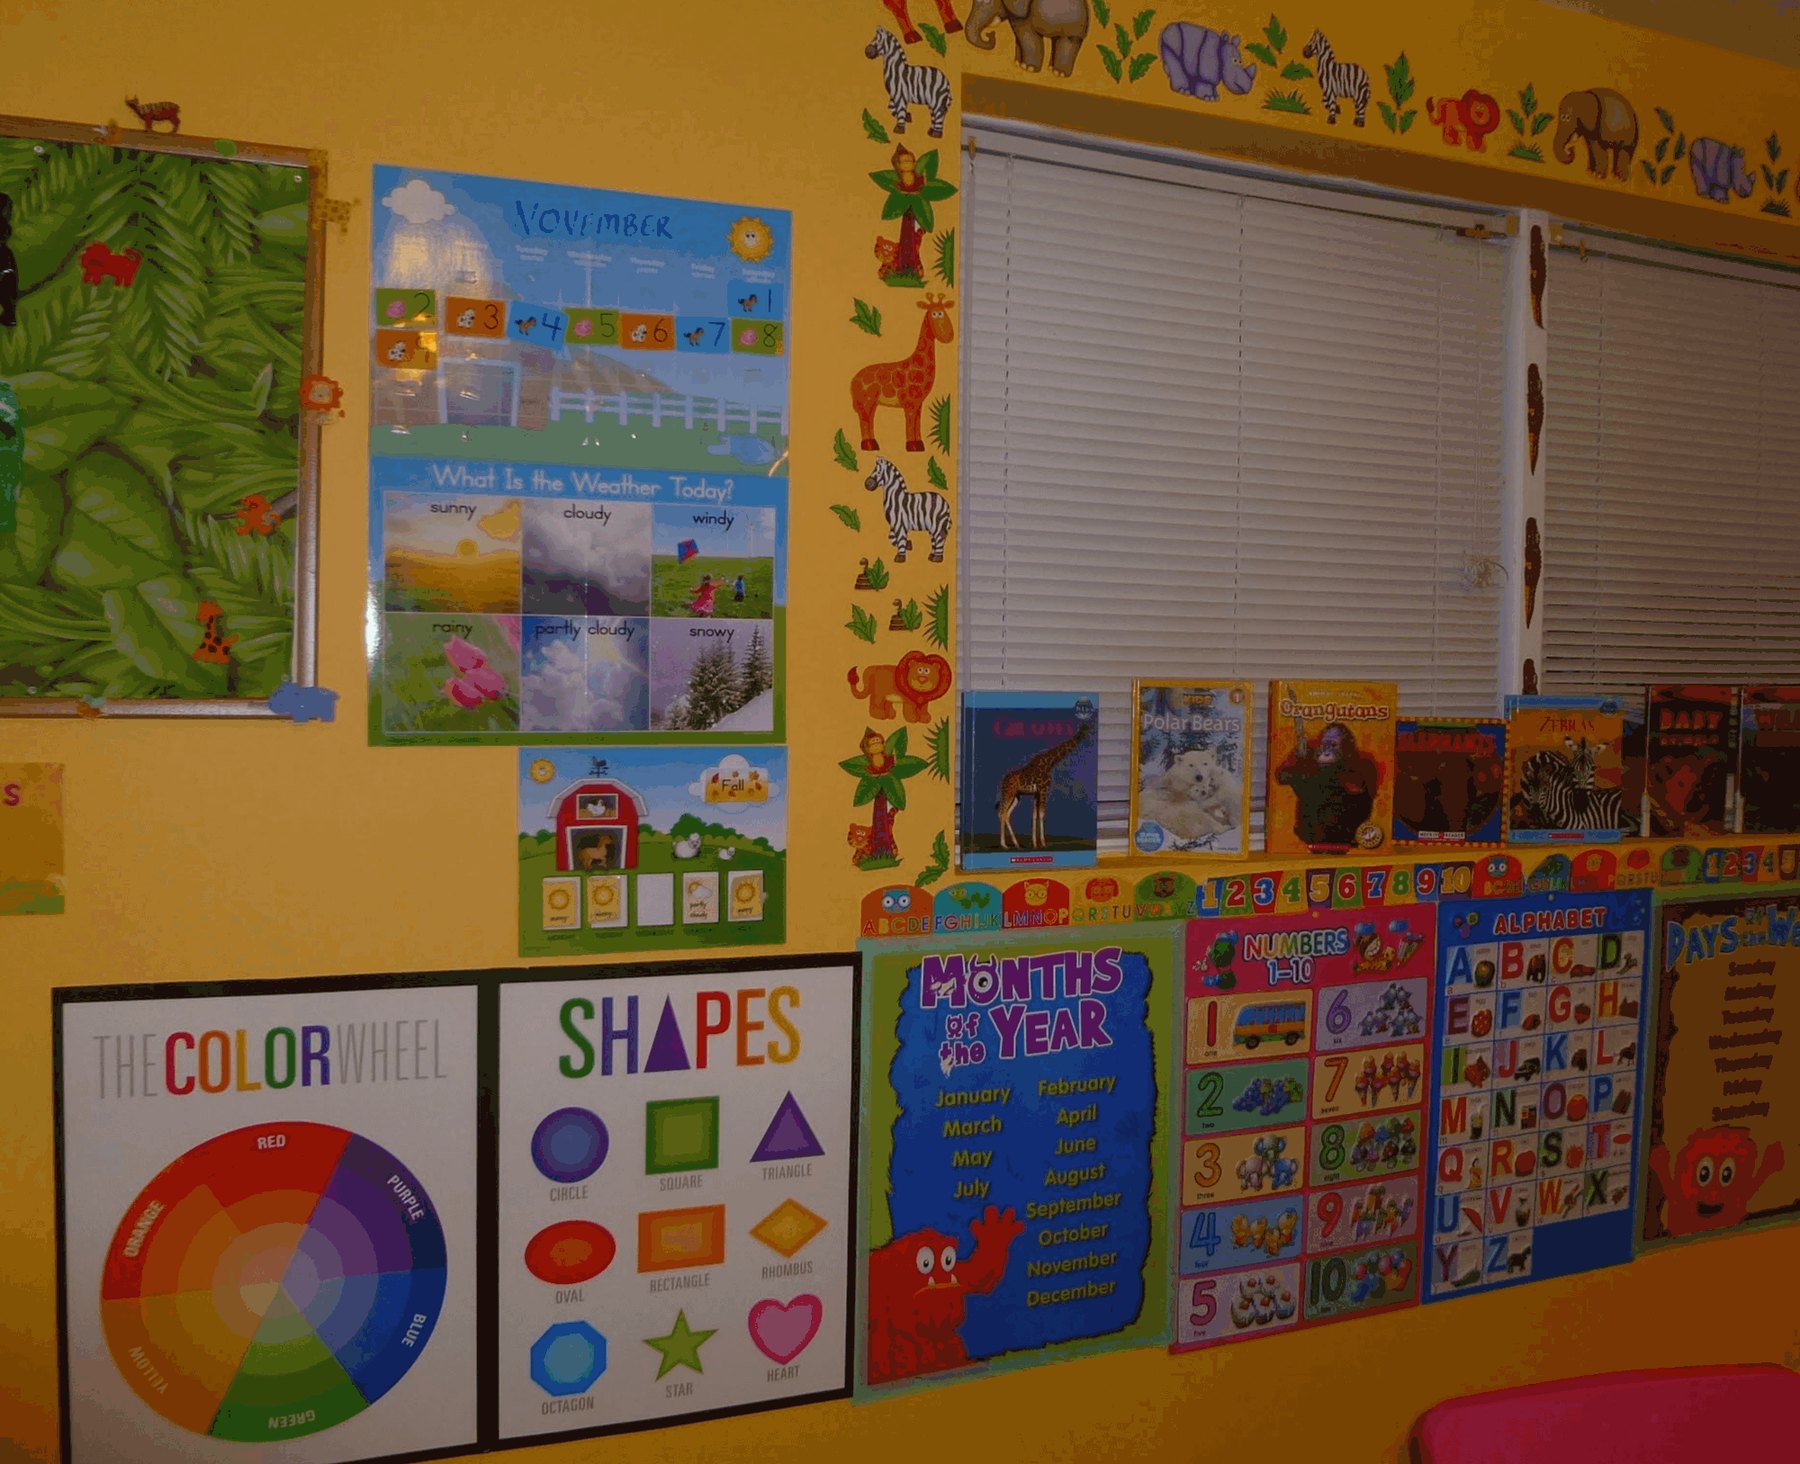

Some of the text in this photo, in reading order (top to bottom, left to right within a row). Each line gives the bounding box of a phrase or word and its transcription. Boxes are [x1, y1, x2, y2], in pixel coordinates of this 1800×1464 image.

[484, 304, 499, 330] 3
[541, 316, 562, 341] 4
[600, 313, 615, 338] 5
[653, 318, 668, 343] 6
[708, 321, 725, 346] 7
[762, 323, 777, 348] 8
[431, 464, 734, 502] What Is the Weather Today?
[430, 502, 477, 520] sunny
[563, 505, 612, 526] cloudy
[692, 511, 734, 531] windy
[432, 620, 473, 639] rainy
[535, 620, 635, 641] partly cloudy
[689, 626, 735, 642] snowy
[1143, 714, 1240, 732] Polar Bears
[1280, 699, 1390, 722] Orangutans
[722, 779, 745, 792] Fall
[1723, 851, 1739, 876] 2
[1742, 851, 1758, 874] 3
[1203, 880, 1218, 909] 1
[1226, 878, 1246, 908] 2
[1253, 876, 1275, 906] 3
[1282, 876, 1302, 903] 4
[1309, 873, 1330, 902] 5
[1337, 872, 1357, 899] 6
[1366, 871, 1387, 898] 7
[1391, 869, 1411, 896] 8
[1416, 867, 1436, 895] 9
[1440, 866, 1472, 894] 10
[862, 915, 930, 936] ABCDE
[1003, 908, 1068, 929] LMNOP
[1493, 906, 1607, 936] ALPHABET
[1243, 927, 1351, 961] NUMBERS
[1666, 914, 1739, 973] DAYS
[1267, 957, 1315, 986] 1-10
[1449, 934, 1622, 984] A B C D
[920, 946, 1124, 1009] MONTHS
[1326, 989, 1352, 1034] 6
[1448, 981, 1618, 1035] E F G H
[945, 1010, 981, 1039] of
[988, 999, 1114, 1060] YEAR
[1206, 1000, 1217, 1047] 1
[93, 1018, 447, 1100] THE COLOR WHEEL
[939, 1040, 987, 1070] the
[1498, 1040, 1517, 1078] J
[1546, 1034, 1568, 1072] K
[1597, 1030, 1614, 1065] L
[1038, 1074, 1117, 1098] February
[1324, 1056, 1349, 1103] 7
[934, 1085, 1011, 1109] January
[1197, 1072, 1224, 1118] 2
[1441, 1076, 1613, 1136] M N O P
[943, 1117, 1002, 1138] March
[1055, 1105, 1097, 1127] April
[257, 1134, 287, 1150] RED
[1054, 1136, 1097, 1157] June
[1319, 1124, 1346, 1171] 8
[1438, 1124, 1611, 1182] Q R S T
[762, 1163, 813, 1181] TRIANGLE
[952, 1149, 993, 1170] May
[1194, 1142, 1222, 1188] 3
[659, 1174, 703, 1192] SQUARE
[953, 1178, 990, 1199] July
[1044, 1163, 1107, 1187] August
[387, 1174, 424, 1222] PURPLE
[549, 1185, 588, 1202] CIRCLE
[1026, 1191, 1122, 1221] September
[1438, 1170, 1608, 1233] U V W X
[123, 1200, 165, 1257] ORANGE
[1317, 1192, 1344, 1238] 9
[1038, 1222, 1109, 1247] October
[1189, 1212, 1222, 1257] 4
[762, 1261, 813, 1280] RHOMBUS
[1026, 1250, 1117, 1278] November
[1437, 1236, 1508, 1282] Y Z
[649, 1273, 711, 1293] RECTANGLE
[1026, 1280, 1117, 1308] December
[1309, 1258, 1347, 1305] 10
[555, 1289, 584, 1305] OVAL
[1189, 1279, 1217, 1326] 5
[401, 1313, 427, 1349] BLUE
[129, 1344, 169, 1394] YELLOW
[766, 1365, 800, 1383] HEART
[665, 1382, 694, 1398] STAR
[268, 1409, 316, 1430] GREEN
[541, 1397, 595, 1416] OCTAGON
